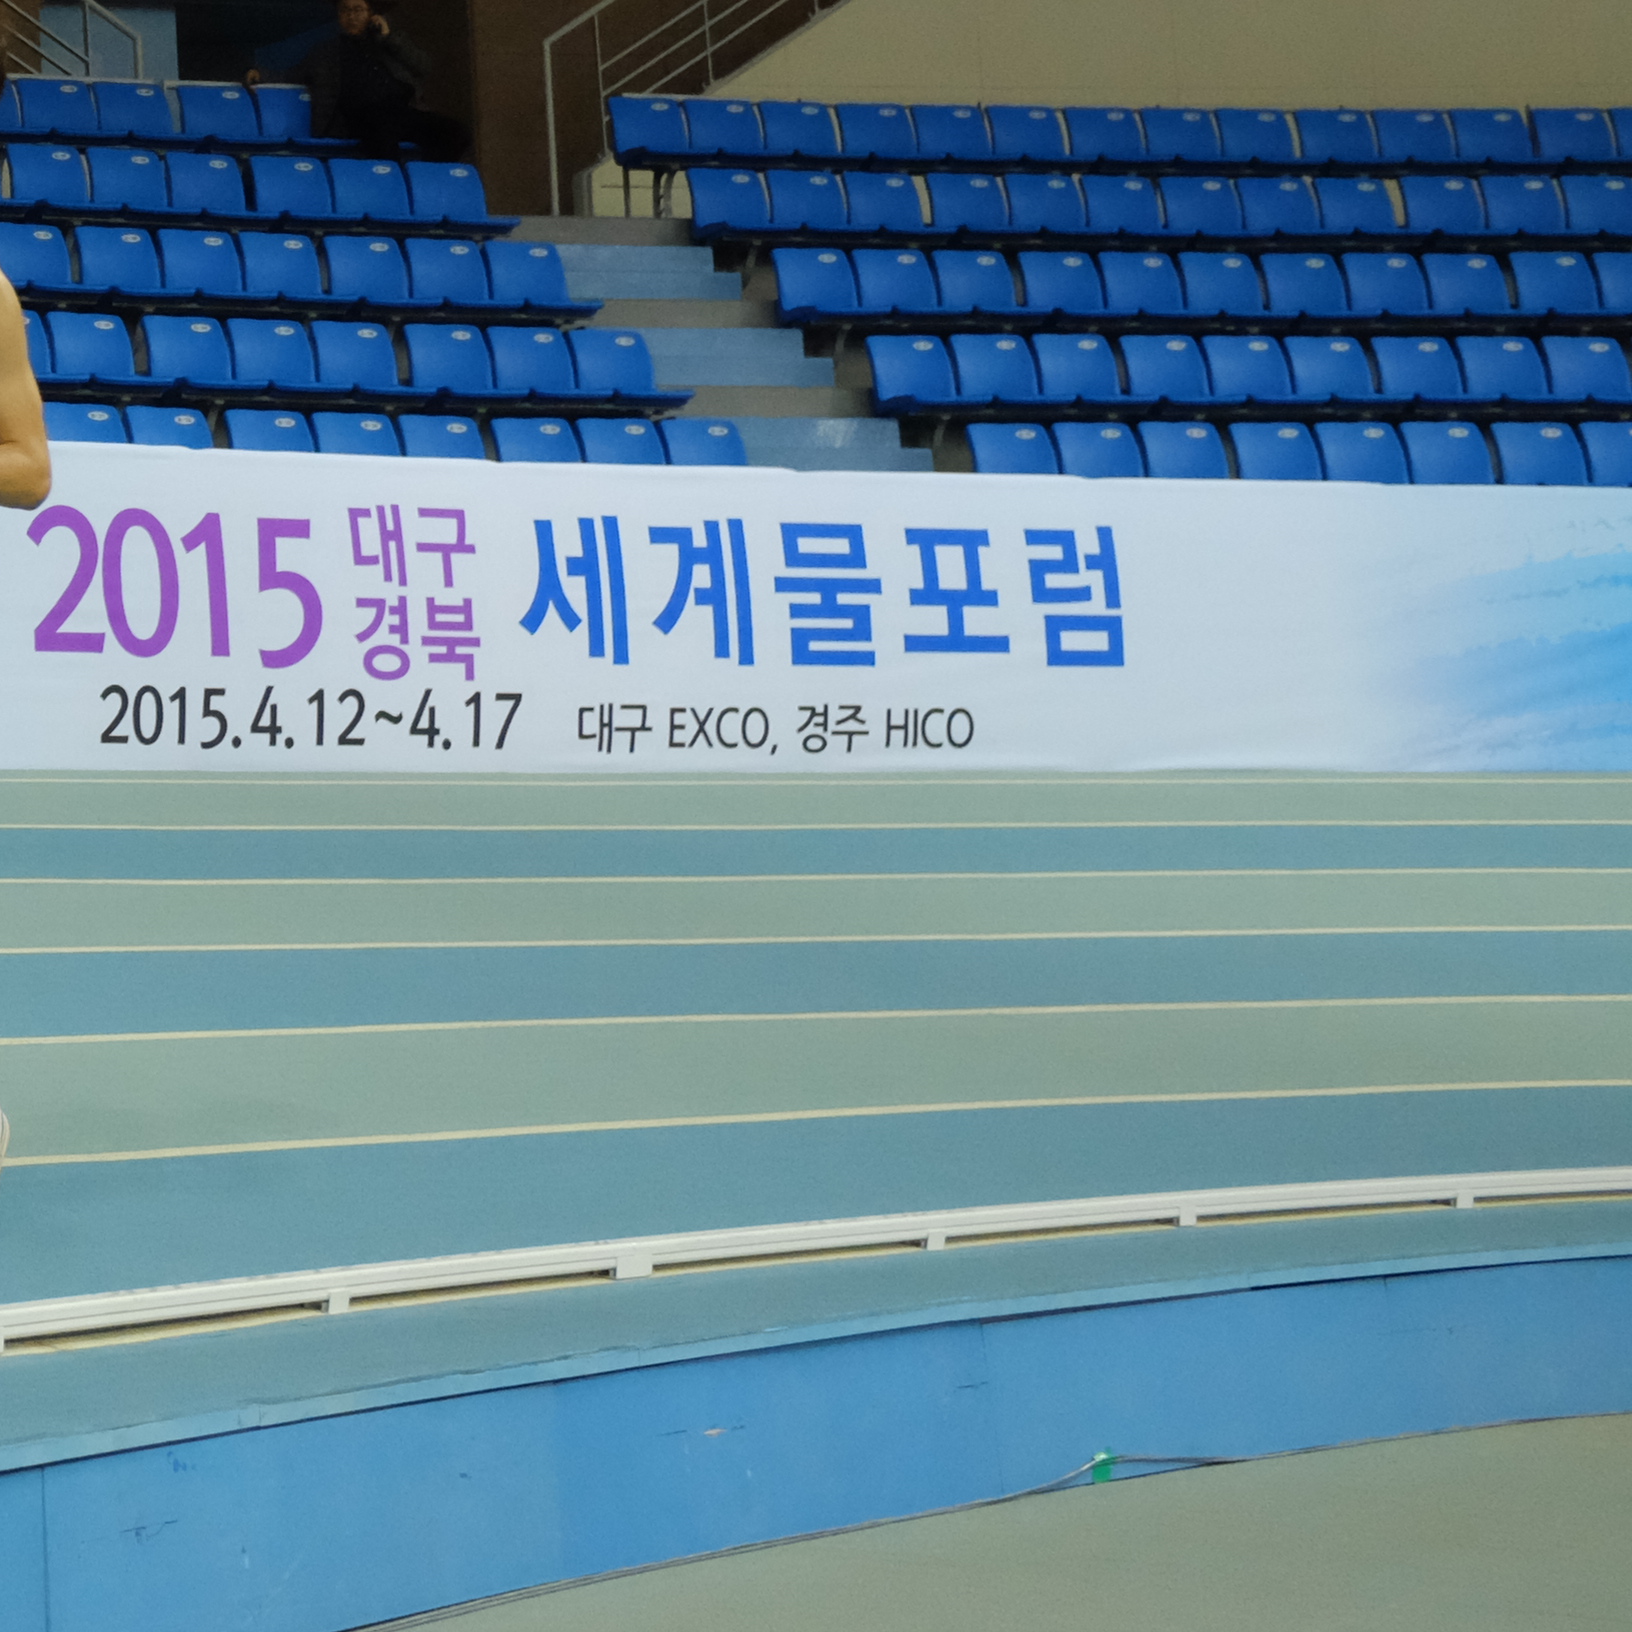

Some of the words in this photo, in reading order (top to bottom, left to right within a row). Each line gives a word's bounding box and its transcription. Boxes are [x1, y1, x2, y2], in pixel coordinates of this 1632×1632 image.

[25, 503, 324, 669] 2015
[350, 503, 477, 590] 대구
[519, 514, 1125, 669] 세계물포럼
[352, 594, 482, 682] 경북
[99, 685, 524, 752] 2015.4.12~4.17
[578, 703, 653, 754] 대구
[669, 707, 778, 755] EXCO,
[796, 704, 868, 753] 경주
[886, 707, 974, 749] HICO
